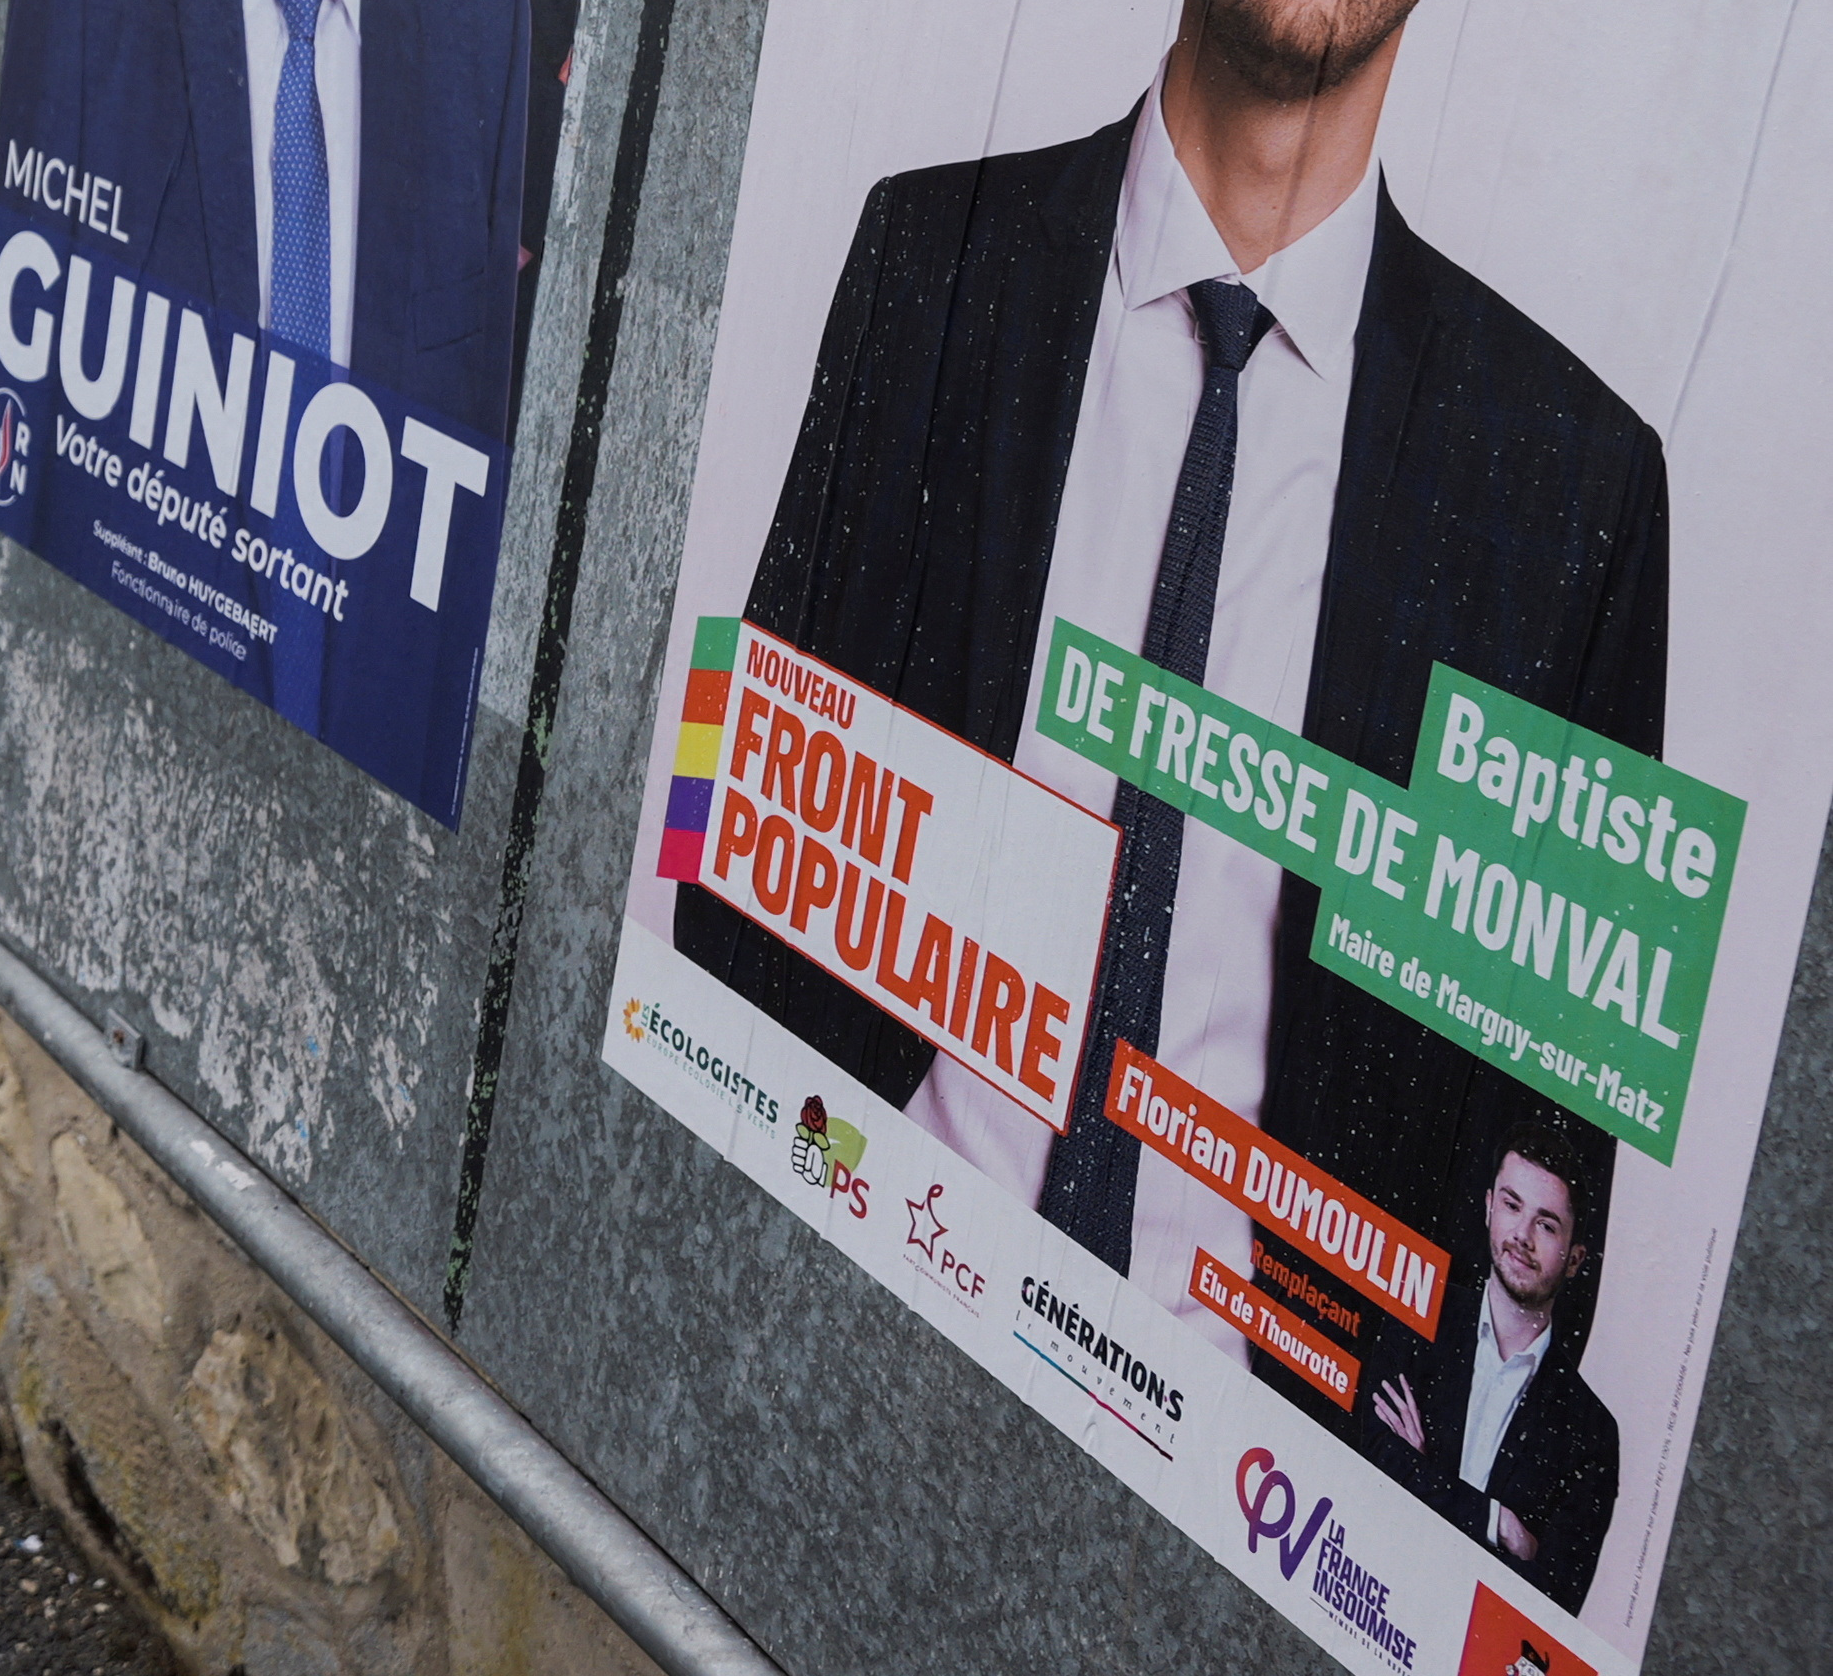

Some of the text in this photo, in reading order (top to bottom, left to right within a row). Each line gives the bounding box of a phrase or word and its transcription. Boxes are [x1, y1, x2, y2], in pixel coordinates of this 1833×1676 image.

[4, 138, 130, 244] MICHEL
[56, 413, 349, 622] Votre député sortant
[147, 550, 188, 590] Bruno
[188, 574, 278, 645] HUYGEBAERT
[191, 612, 208, 638] de
[209, 626, 247, 661] police
[746, 639, 856, 729] NOUVEAU
[730, 686, 934, 885] FRONT
[1436, 692, 1717, 899] Baptiste
[1055, 645, 1680, 1050] DE FRESSE DE MONVAL
[713, 787, 1070, 1103] POPULAIRE
[649, 1002, 779, 1124] ÉCOLOGISTES
[1328, 913, 1664, 1134] Maire de Margny-sur-Matz
[830, 1159, 870, 1219] PS
[1117, 1063, 1436, 1318] Florian DUMOULIN
[940, 1249, 985, 1299] PCF
[1199, 1262, 1349, 1395] Élu de Thourotte
[1251, 1238, 1361, 1338] Remplaçant
[1317, 1537, 1390, 1616] FRANCE
[1328, 1519, 1345, 1549] LA
